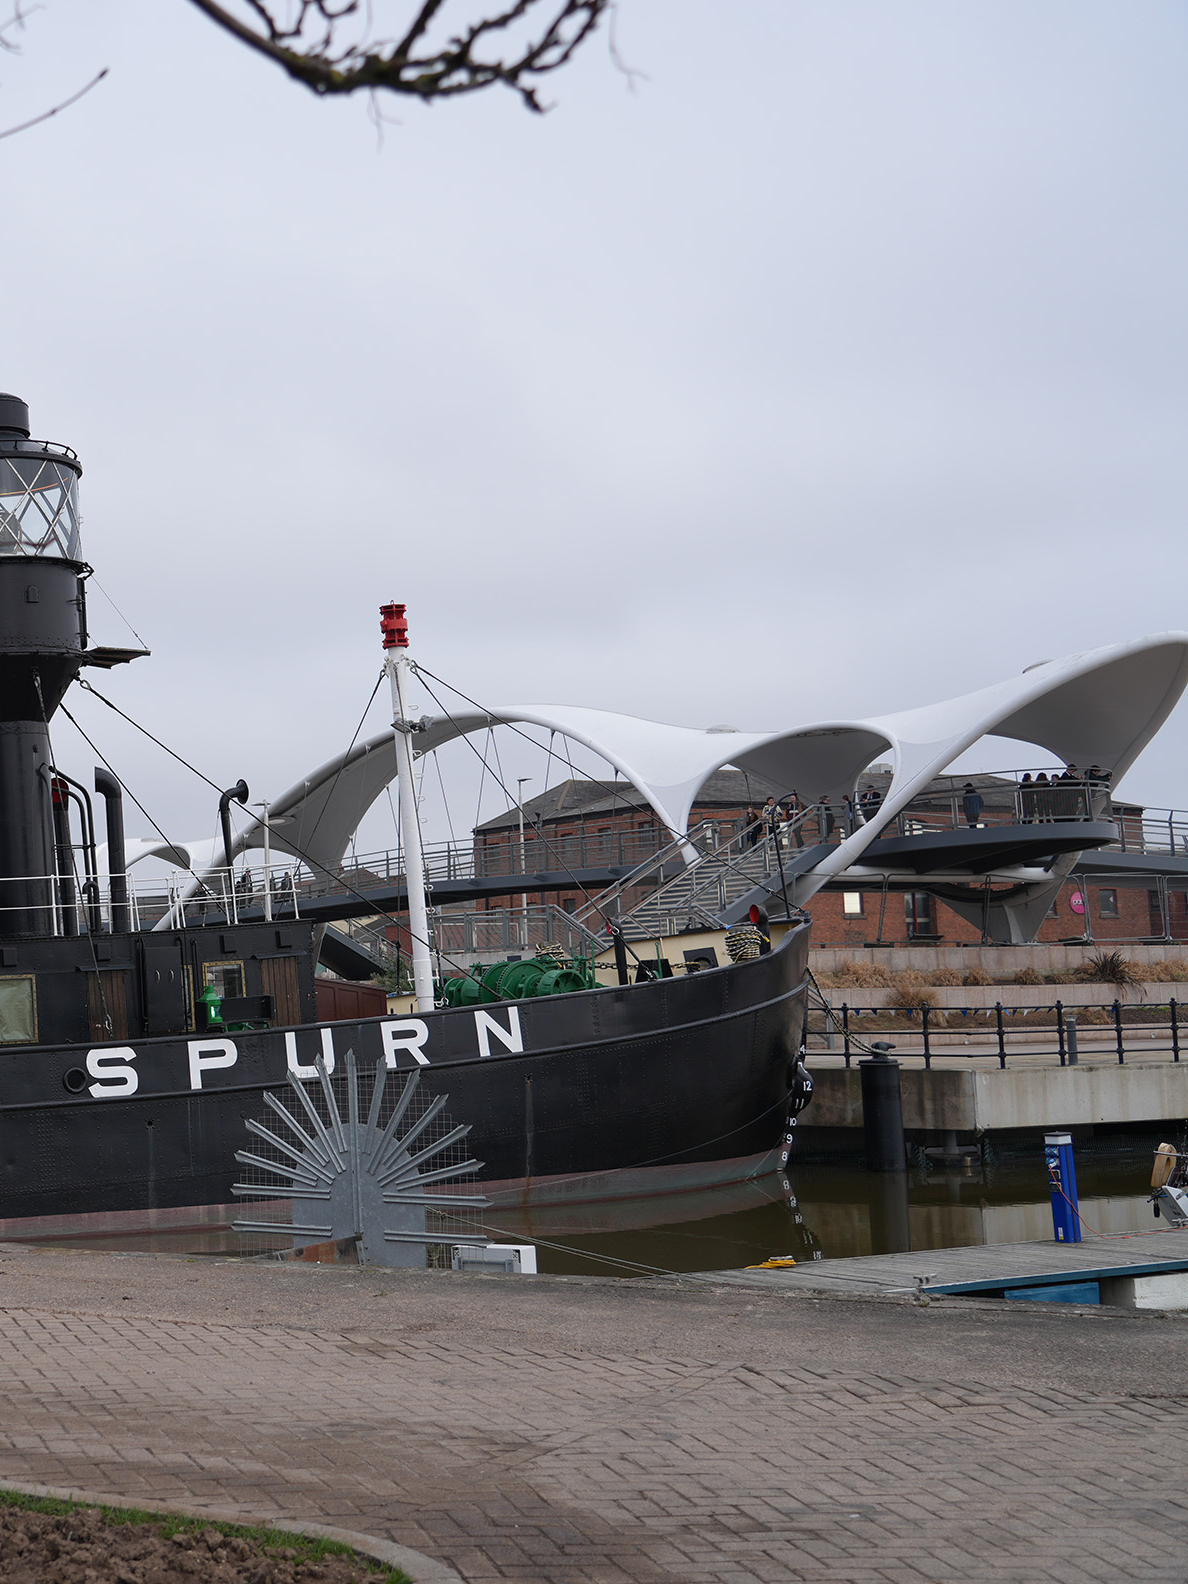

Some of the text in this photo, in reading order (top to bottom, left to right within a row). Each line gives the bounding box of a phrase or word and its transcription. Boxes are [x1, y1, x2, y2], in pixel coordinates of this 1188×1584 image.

[85, 1005, 524, 1099] SPURN
[803, 1080, 812, 1092] 12
[795, 1098, 805, 1109] 11
[789, 1117, 797, 1127] 10
[786, 1133, 793, 1144] 9
[781, 1151, 788, 1161] 8
